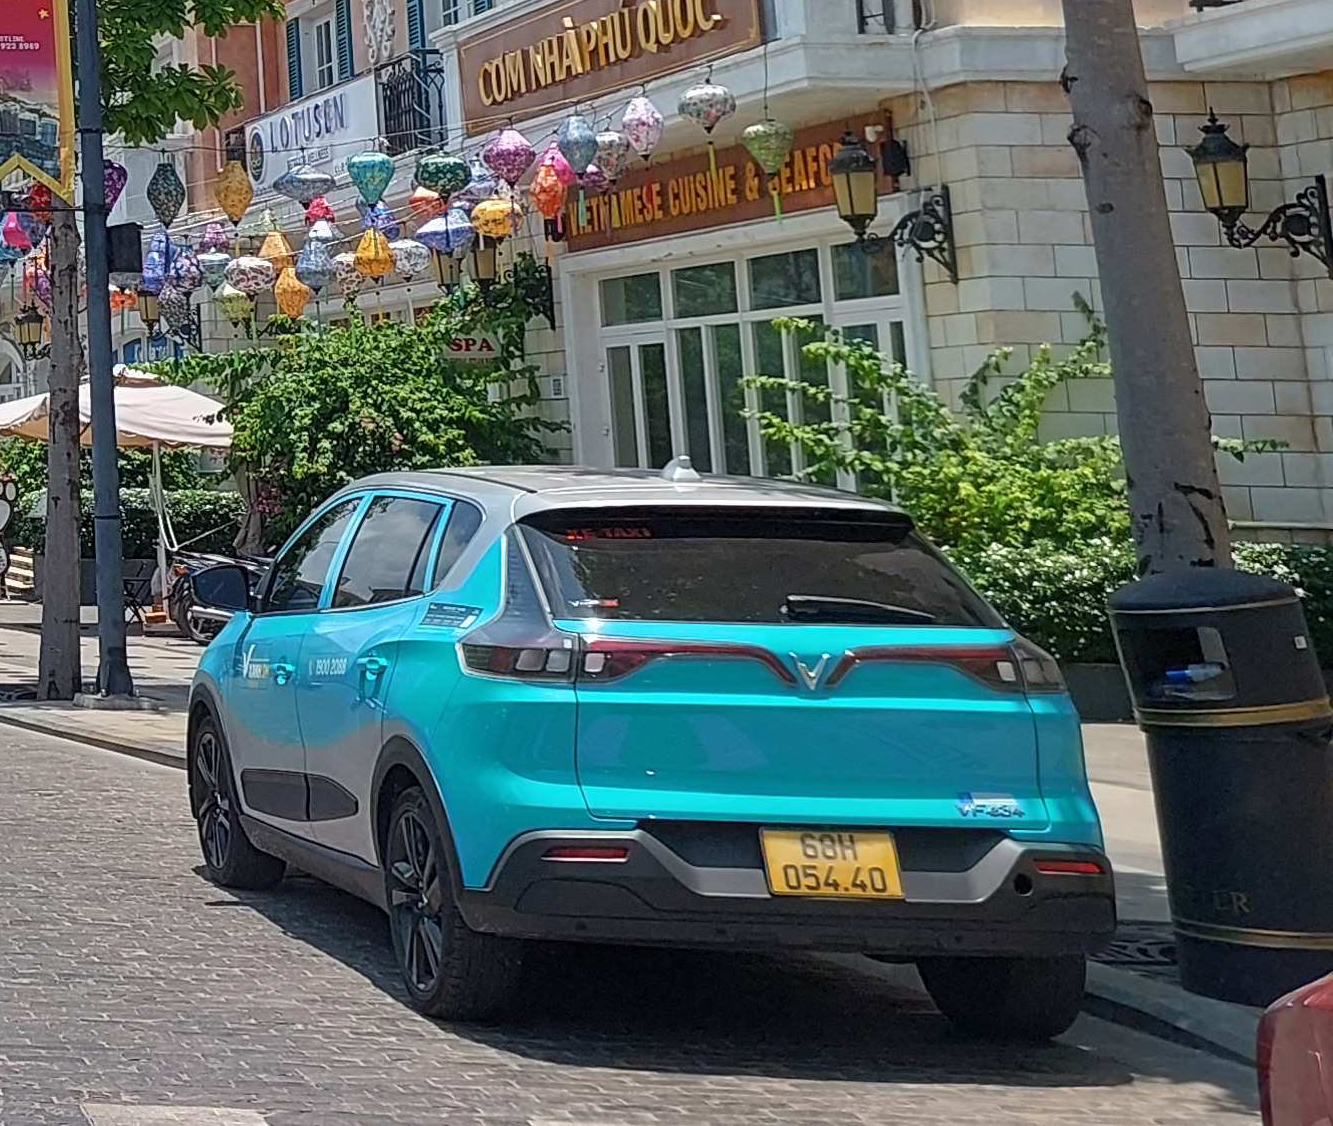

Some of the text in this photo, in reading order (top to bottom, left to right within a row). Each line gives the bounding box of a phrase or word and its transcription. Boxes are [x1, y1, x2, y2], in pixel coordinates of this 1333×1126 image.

[529, 17, 584, 90] NHÀ
[269, 92, 346, 154] LOTUSEN
[669, 165, 738, 218] CUISINE
[746, 162, 759, 201] &
[449, 337, 495, 352] SPA
[316, 658, 330, 675] 1900
[799, 832, 858, 861] 68H
[782, 864, 888, 894] 054.40
